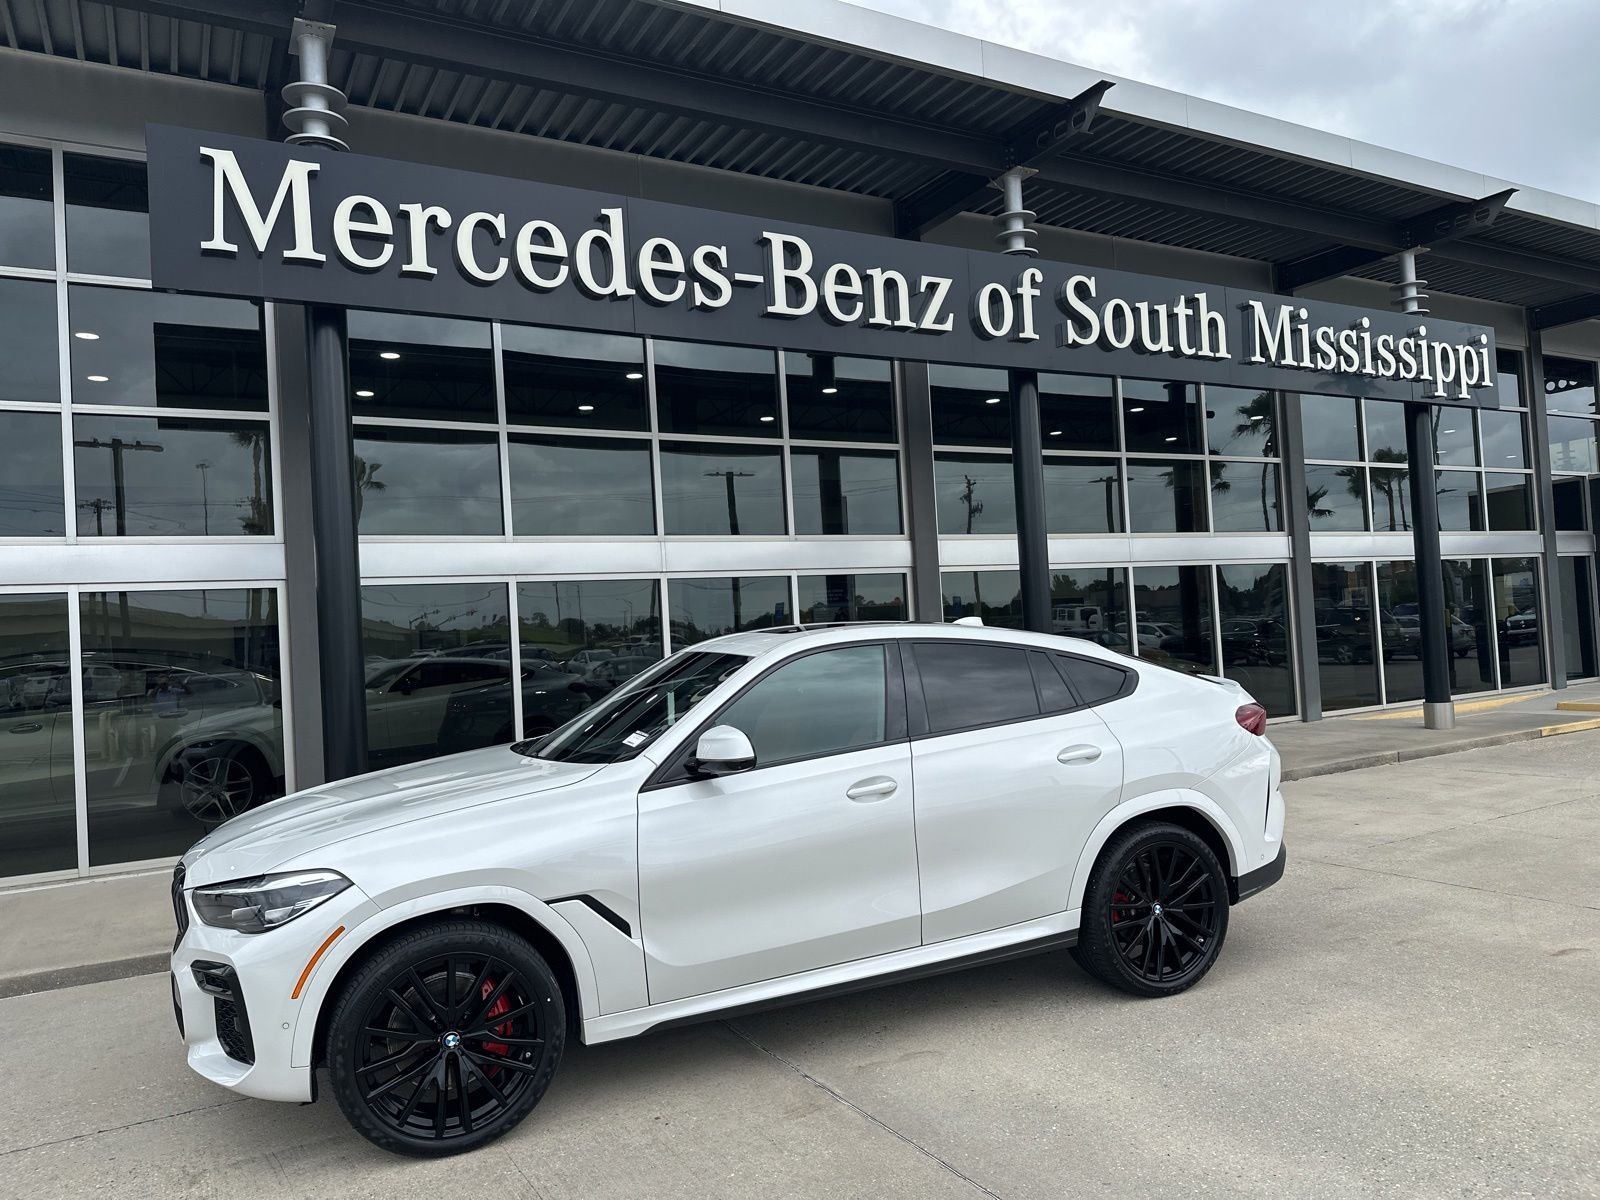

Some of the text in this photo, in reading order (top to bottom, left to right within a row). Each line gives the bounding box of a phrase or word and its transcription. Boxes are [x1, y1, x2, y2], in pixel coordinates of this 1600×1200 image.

[199, 146, 1495, 399] Mercedes-Benz of South Mississippi
